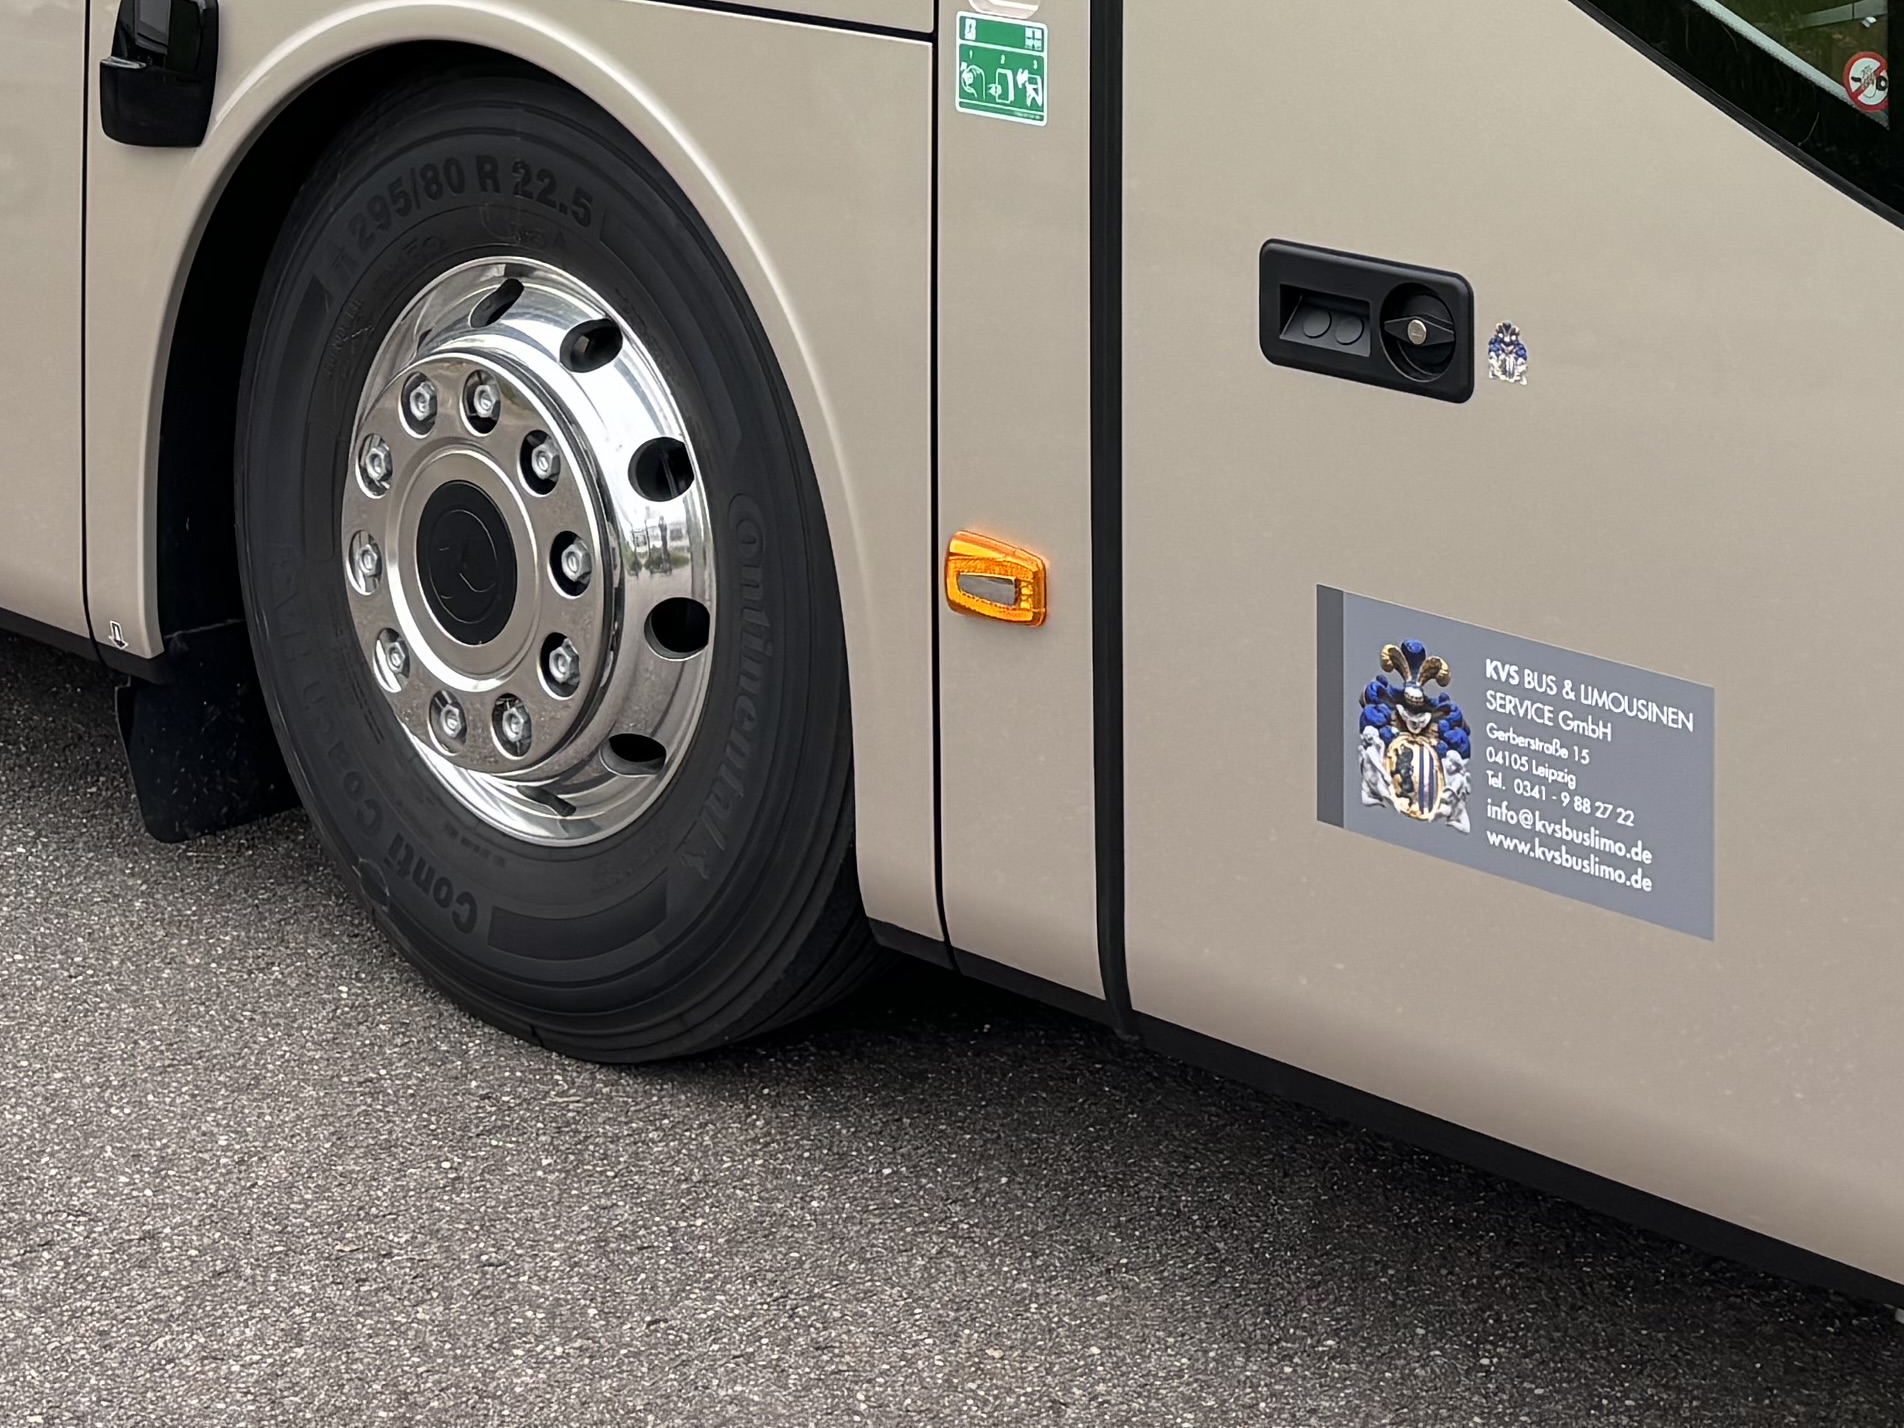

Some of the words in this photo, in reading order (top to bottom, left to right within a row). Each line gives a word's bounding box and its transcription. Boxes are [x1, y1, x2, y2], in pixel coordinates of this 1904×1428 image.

[348, 156, 466, 253] 295/80
[475, 154, 501, 194] R
[511, 159, 594, 228] 22.5
[696, 492, 775, 851] Continental
[1485, 658, 1519, 686] KVS
[1524, 669, 1557, 695] BUS
[1562, 679, 1576, 701] &
[1580, 684, 1694, 732] LIMOUSINEN
[1486, 690, 1554, 726] SERVICE
[1558, 710, 1612, 742] GmbH
[1486, 722, 1569, 759] Gerberstraße
[1573, 746, 1590, 765] 15
[302, 679, 384, 838] Coach
[1486, 746, 1529, 771] 04105
[1532, 759, 1576, 790] Leipzig
[1486, 770, 1506, 790] Tel.
[1513, 778, 1546, 801] 0341
[1561, 791, 1570, 807] 9
[1573, 795, 1591, 814] 88
[1595, 801, 1613, 819] 27
[1616, 808, 1635, 827] 22
[1487, 798, 1653, 865] info@kvsbuslimo.de
[383, 832, 478, 935] Conti
[1486, 830, 1653, 892] www.kvsbuslimo.de
